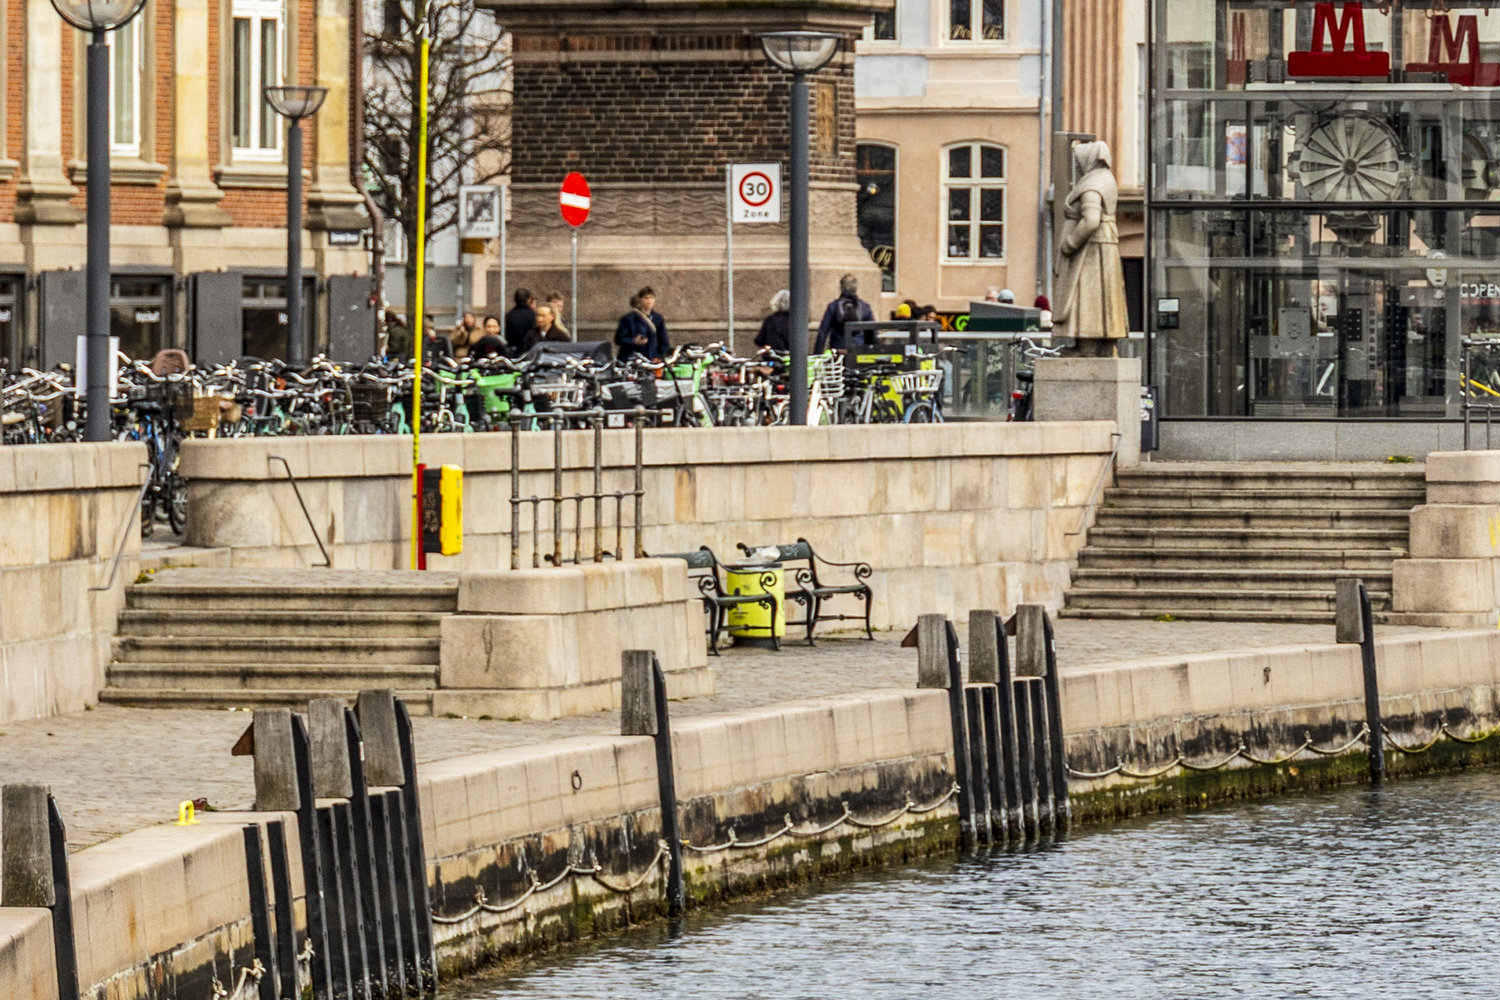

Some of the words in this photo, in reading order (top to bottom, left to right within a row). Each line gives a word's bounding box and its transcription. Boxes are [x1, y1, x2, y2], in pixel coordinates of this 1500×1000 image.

[1310, 1, 1368, 53] M
[1427, 14, 1481, 63] M
[745, 182, 767, 196] 30
[744, 209, 770, 218] Zone
